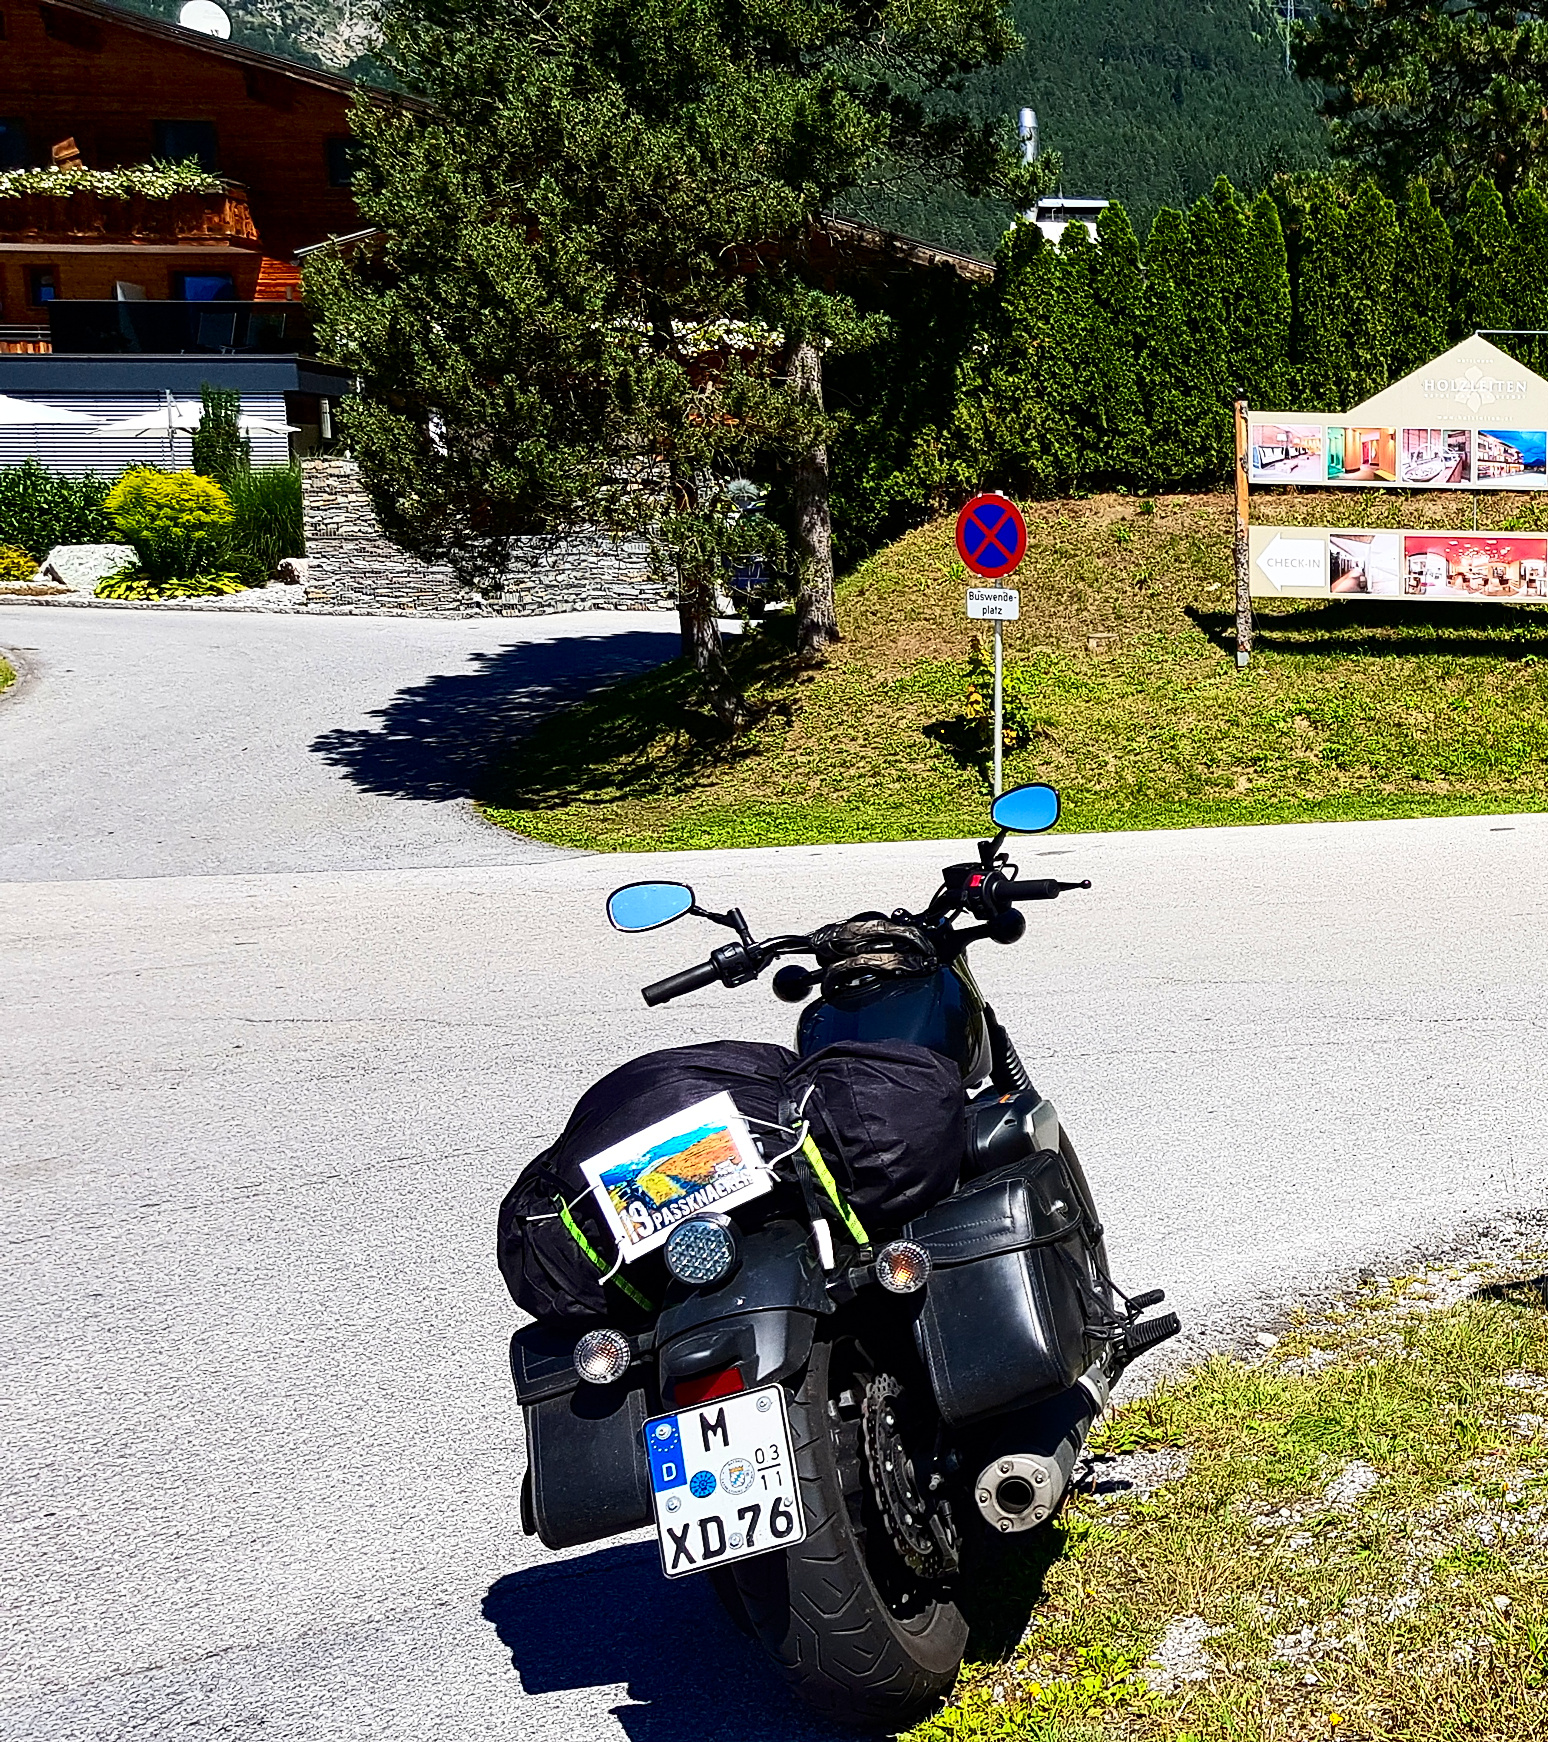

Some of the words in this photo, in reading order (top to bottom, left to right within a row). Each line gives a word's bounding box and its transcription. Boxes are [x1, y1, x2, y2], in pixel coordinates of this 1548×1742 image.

[1424, 379, 1527, 393] HOLZLEITEN
[1266, 557, 1321, 568] CHECK-IN
[968, 591, 1017, 602] Buswende-
[982, 606, 1003, 616] platz
[699, 1406, 730, 1453] M
[755, 1444, 780, 1464] 03
[661, 1462, 677, 1482] D
[761, 1470, 782, 1491] 11
[667, 1515, 727, 1570] XD
[737, 1496, 794, 1548] 76
